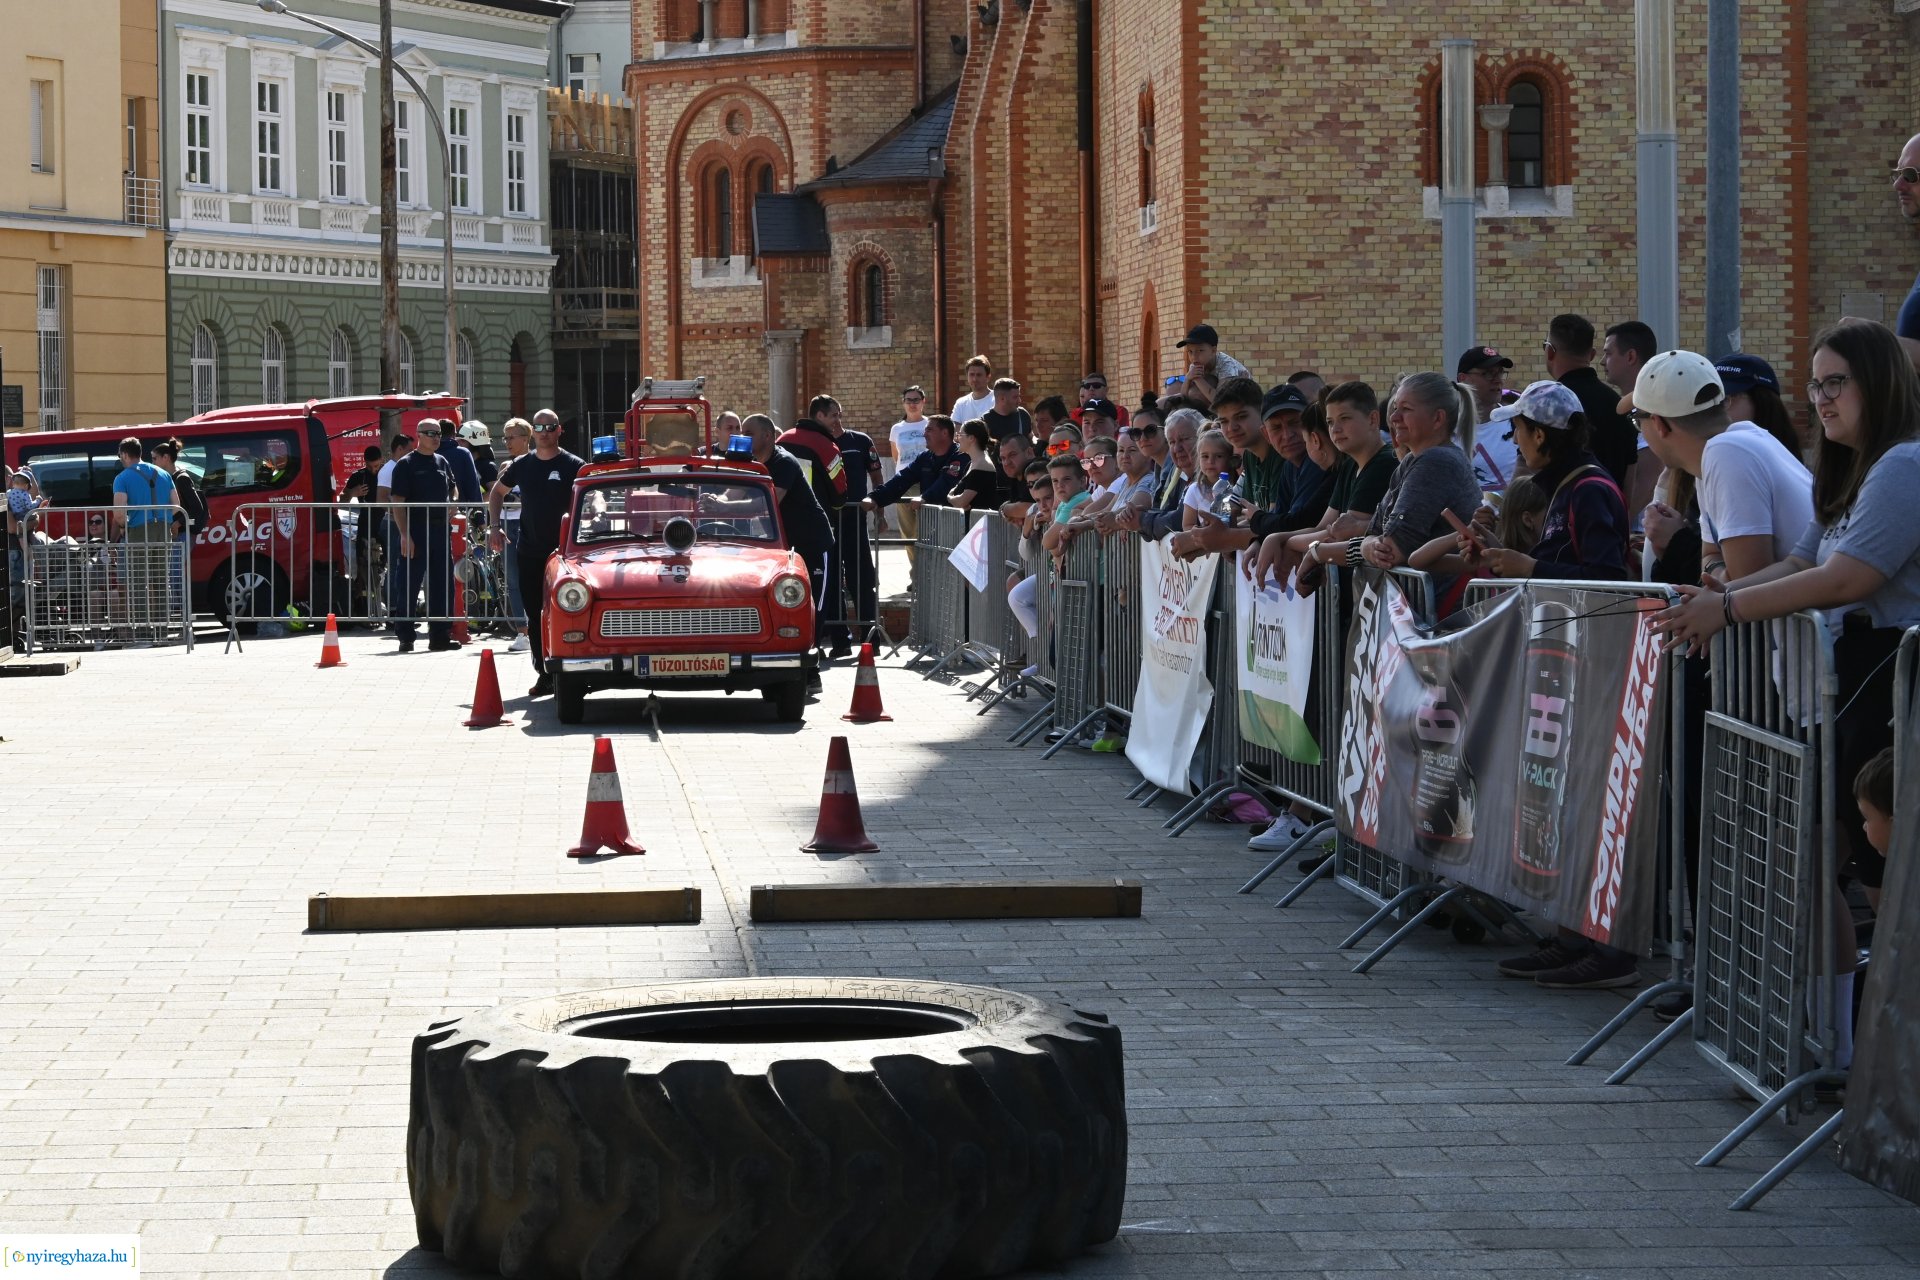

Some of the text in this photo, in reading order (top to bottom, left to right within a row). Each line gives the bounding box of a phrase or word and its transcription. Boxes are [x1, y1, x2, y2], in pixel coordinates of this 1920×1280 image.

[640, 667, 647, 675] H
[652, 657, 725, 673] TŰZOLTÓSÁG
[1338, 582, 1378, 805] BRAND
[1522, 760, 1559, 790] V-PACK
[1589, 611, 1649, 926] COMPLETE
[1600, 741, 1643, 932] VITAMIN
